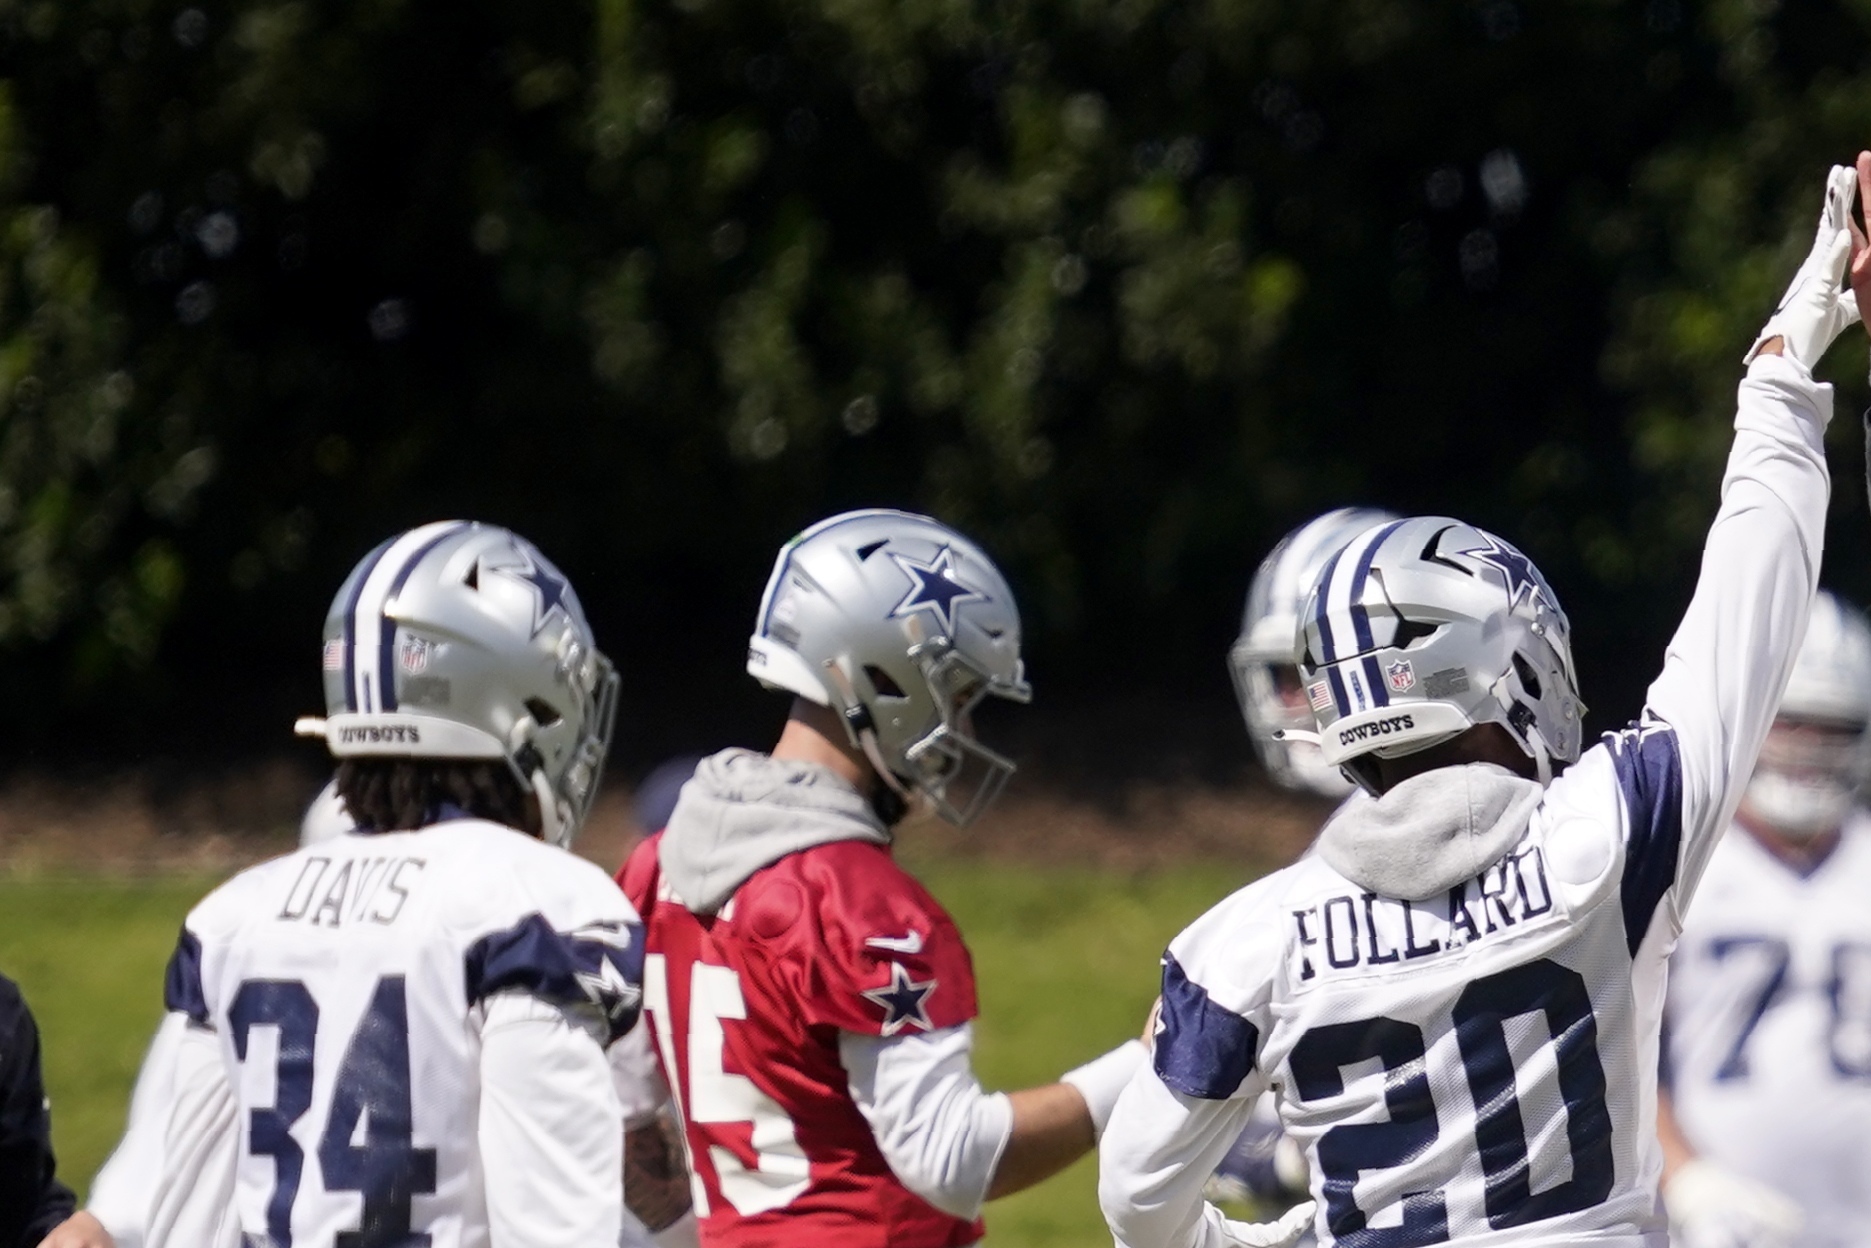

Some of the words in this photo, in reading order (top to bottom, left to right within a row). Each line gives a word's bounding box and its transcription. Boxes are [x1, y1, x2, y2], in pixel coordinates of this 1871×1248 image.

[1339, 714, 1414, 745] COWBOYS
[275, 856, 427, 929] DAVIS
[642, 952, 811, 1220] 15
